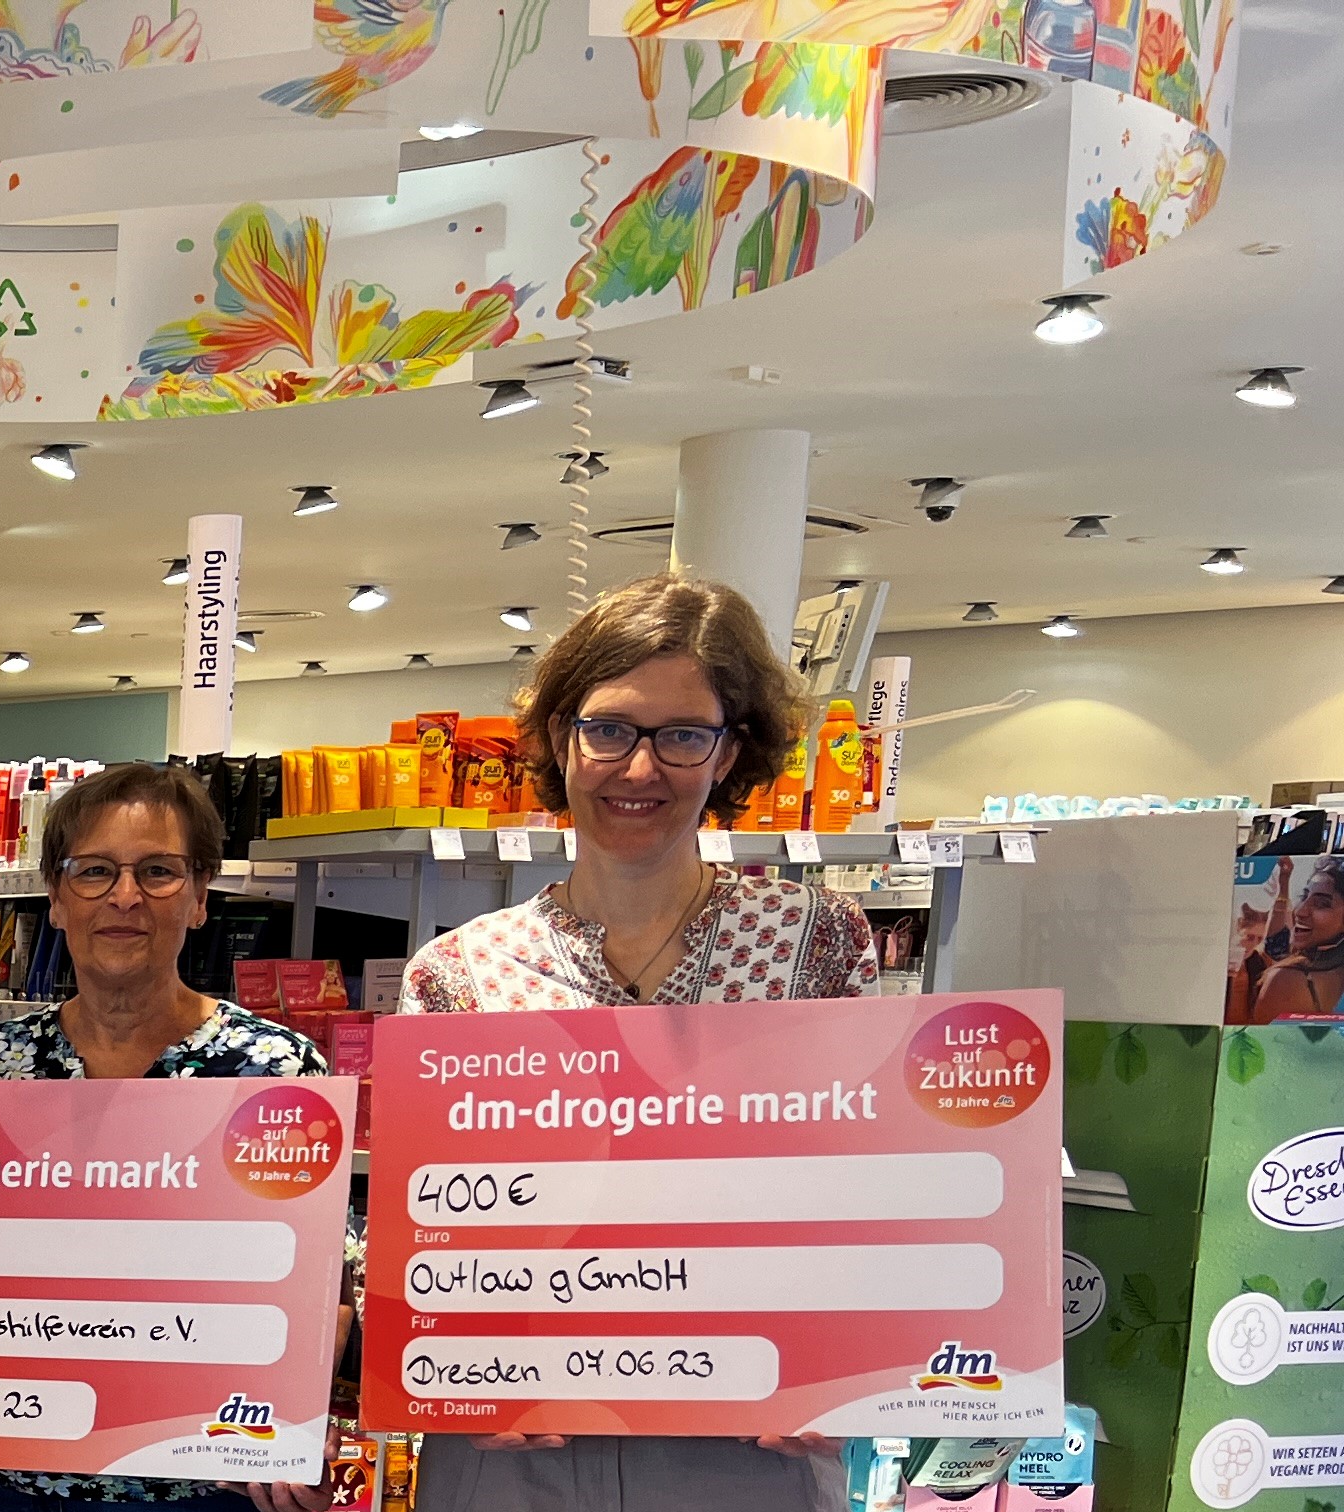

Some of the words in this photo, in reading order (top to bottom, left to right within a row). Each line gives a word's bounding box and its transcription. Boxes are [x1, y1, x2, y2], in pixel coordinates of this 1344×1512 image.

[193, 550, 227, 689] Haarstyling
[332, 774, 350, 786] 30
[393, 773, 410, 785] 30
[474, 791, 493, 804] 50
[777, 794, 798, 809] 30
[829, 789, 850, 803] 30
[944, 1023, 1000, 1046] Lust
[952, 1047, 983, 1064] auf
[418, 1048, 547, 1084] Spende
[559, 1050, 620, 1077] von
[919, 1062, 1036, 1090] Zukunft
[447, 1085, 724, 1137] dm-drogerie
[738, 1081, 878, 1124] markt
[938, 1097, 954, 1109] 50
[956, 1096, 990, 1109] Jahre
[257, 1105, 304, 1124] Lust
[262, 1126, 289, 1141] auf
[234, 1141, 331, 1164] Zukunft
[84, 1153, 200, 1191] markt
[248, 1171, 261, 1181] 50
[263, 1170, 291, 1182] Jahre
[414, 1230, 450, 1244] Euro
[410, 1258, 533, 1294] Outlaw
[411, 1315, 438, 1330] Für
[1287, 1341, 1304, 1353] IST
[1306, 1340, 1330, 1352] UNS
[930, 1344, 992, 1375] dm
[406, 1354, 541, 1386] Dresden
[566, 1349, 714, 1378] 07.06.23
[219, 1396, 271, 1425] dm
[408, 1400, 437, 1419] Ort,
[443, 1401, 497, 1417] Datum
[878, 1401, 904, 1413] HIER
[907, 1400, 926, 1408] BIN
[930, 1400, 948, 1408] ICH
[952, 1401, 997, 1410] MENSCH
[942, 1412, 968, 1421] HIER
[972, 1412, 1000, 1422] KAUF
[1003, 1411, 1022, 1421] ICH
[1026, 1408, 1045, 1419] EIN
[172, 1446, 194, 1455] HIER
[196, 1445, 212, 1453] BIN
[214, 1446, 230, 1454] ICH
[232, 1447, 269, 1457] MENSCH
[1019, 1452, 1064, 1462] HYDRO
[1272, 1448, 1295, 1460] WIR
[1298, 1446, 1338, 1459] SETZEN
[223, 1458, 245, 1467] HIER
[247, 1459, 271, 1468] KAUF
[939, 1459, 996, 1470] COOLING
[1019, 1464, 1051, 1474] HEEL
[933, 1469, 974, 1479] RELAX
[1270, 1464, 1315, 1477] VEGANE
